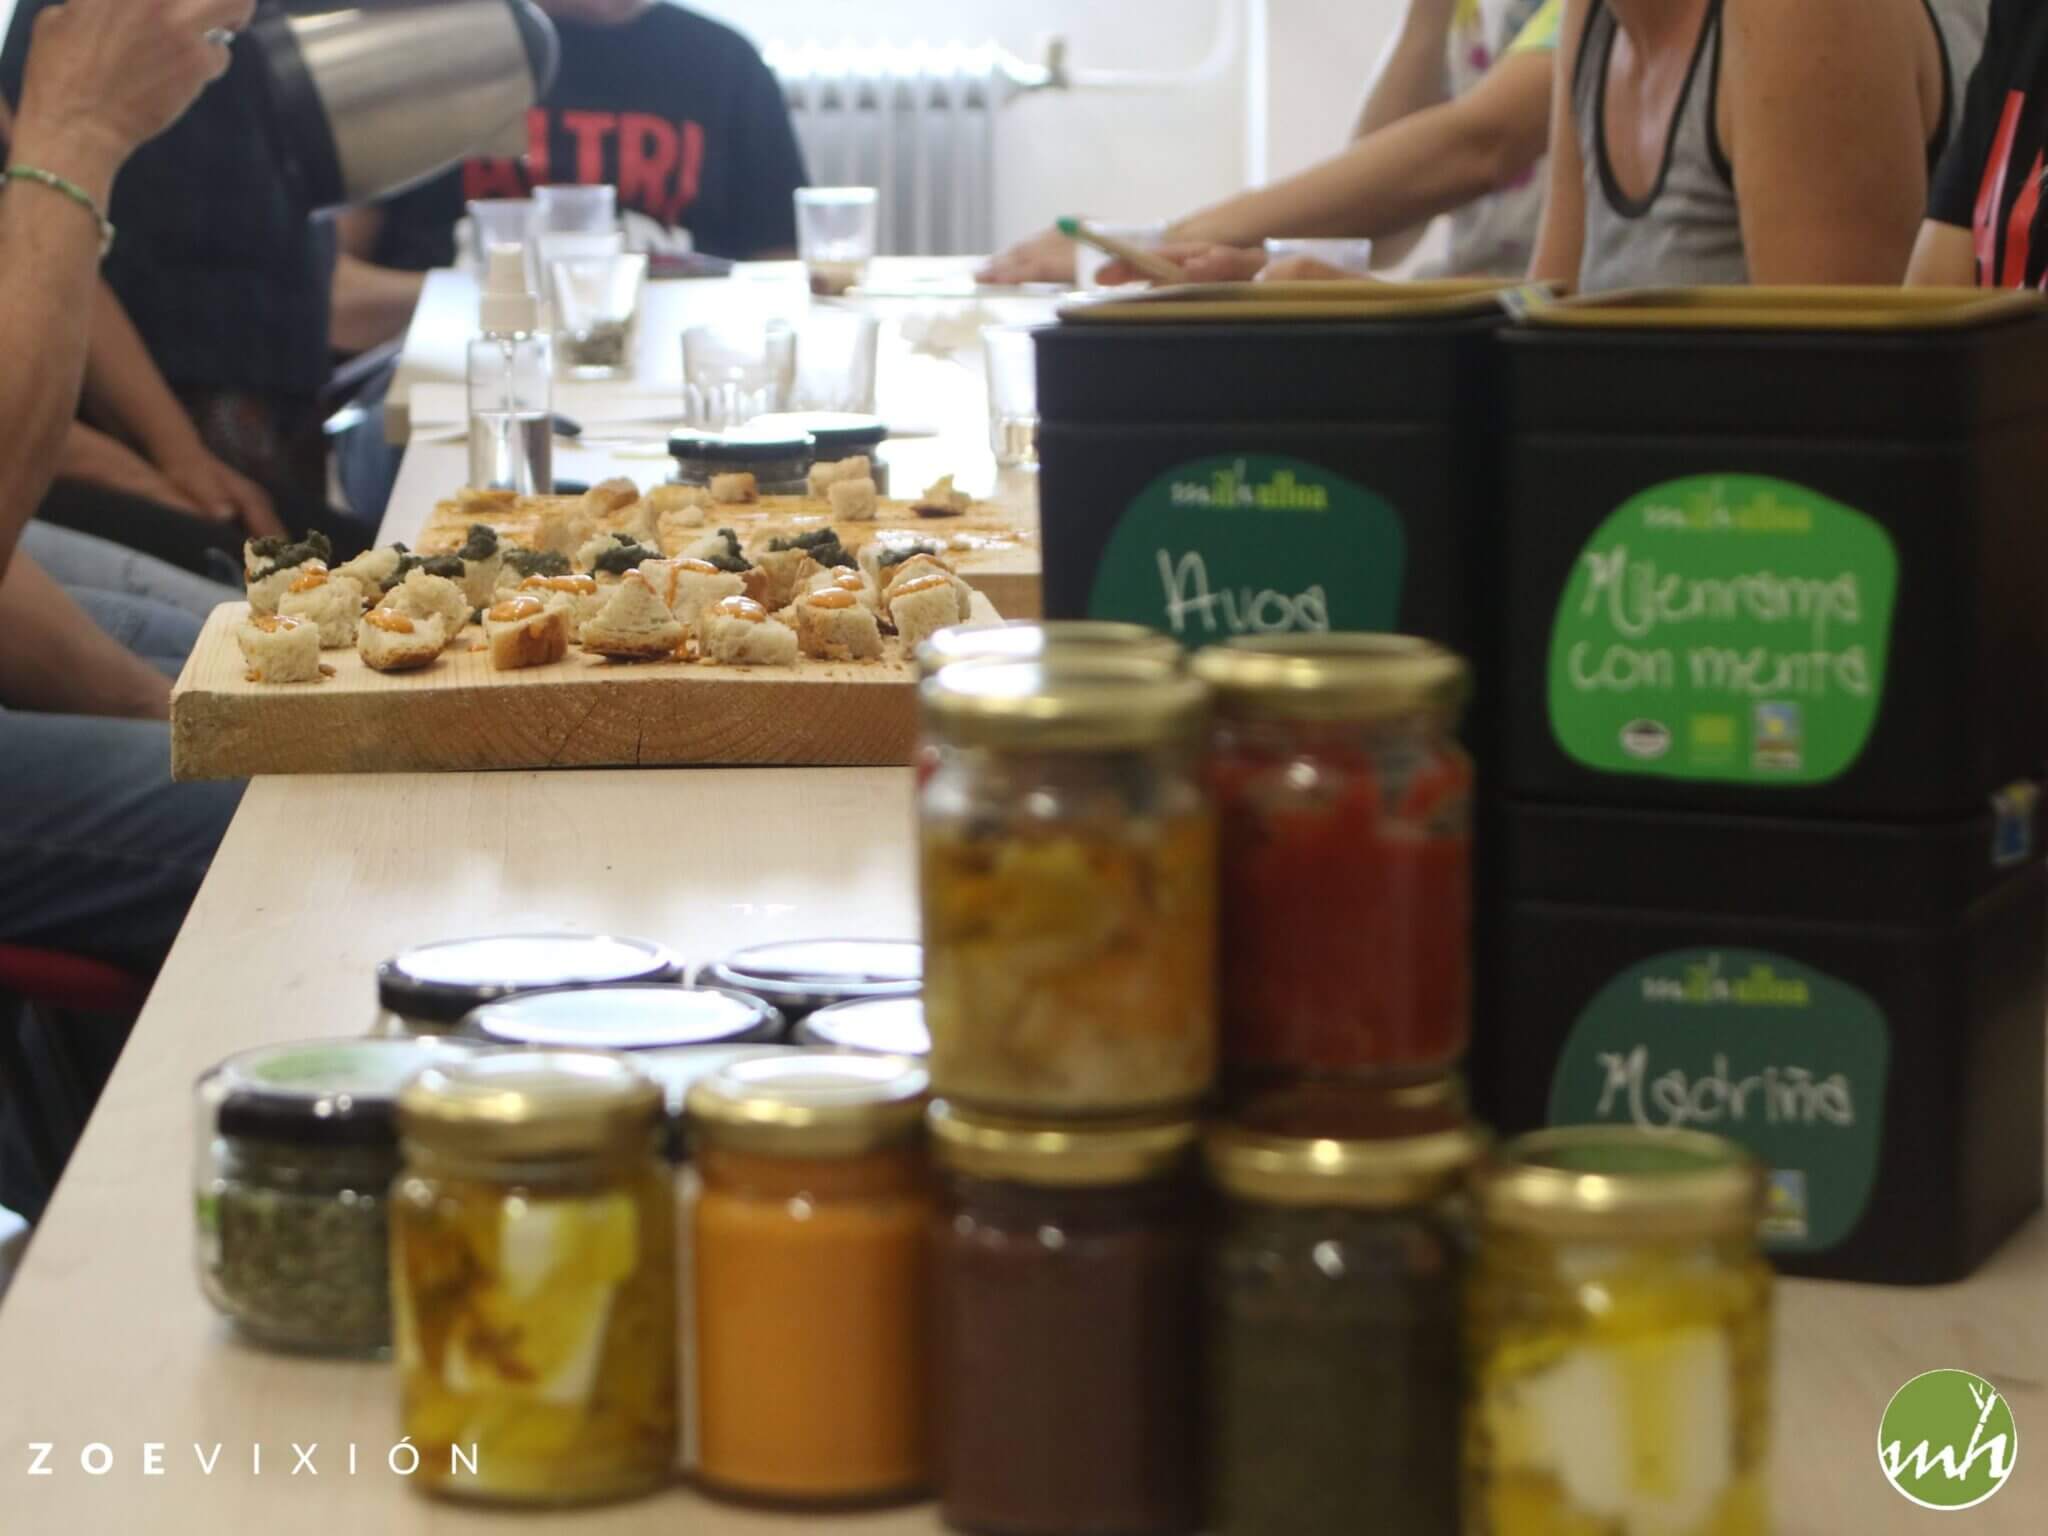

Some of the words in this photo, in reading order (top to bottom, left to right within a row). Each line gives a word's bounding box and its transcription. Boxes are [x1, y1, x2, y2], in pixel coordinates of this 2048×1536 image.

[1569, 642, 1674, 690] con
[1690, 638, 1869, 696] menta
[1597, 1044, 1854, 1134] Madriña
